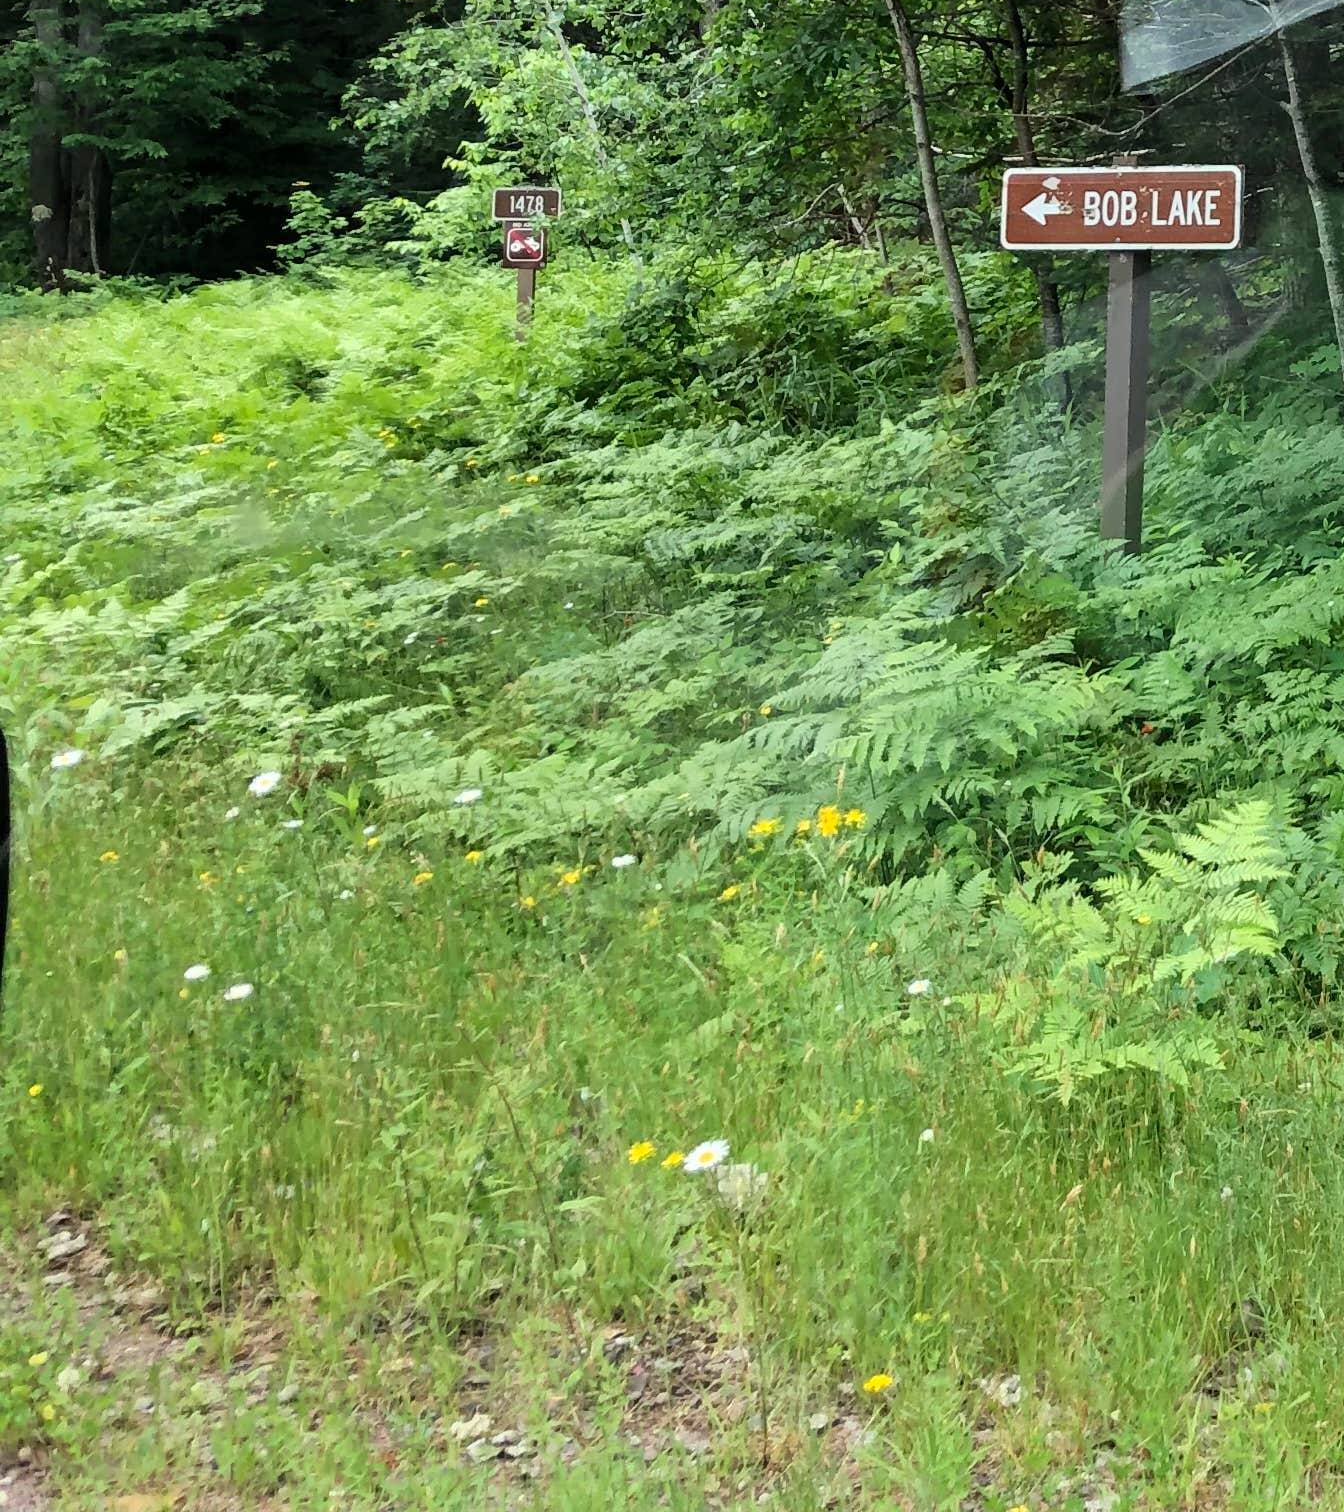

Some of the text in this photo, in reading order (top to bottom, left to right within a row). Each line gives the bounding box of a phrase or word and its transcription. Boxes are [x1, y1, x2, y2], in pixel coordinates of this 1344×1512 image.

[510, 195, 544, 213] 1478
[1083, 190, 1221, 226] BOB LAKE
